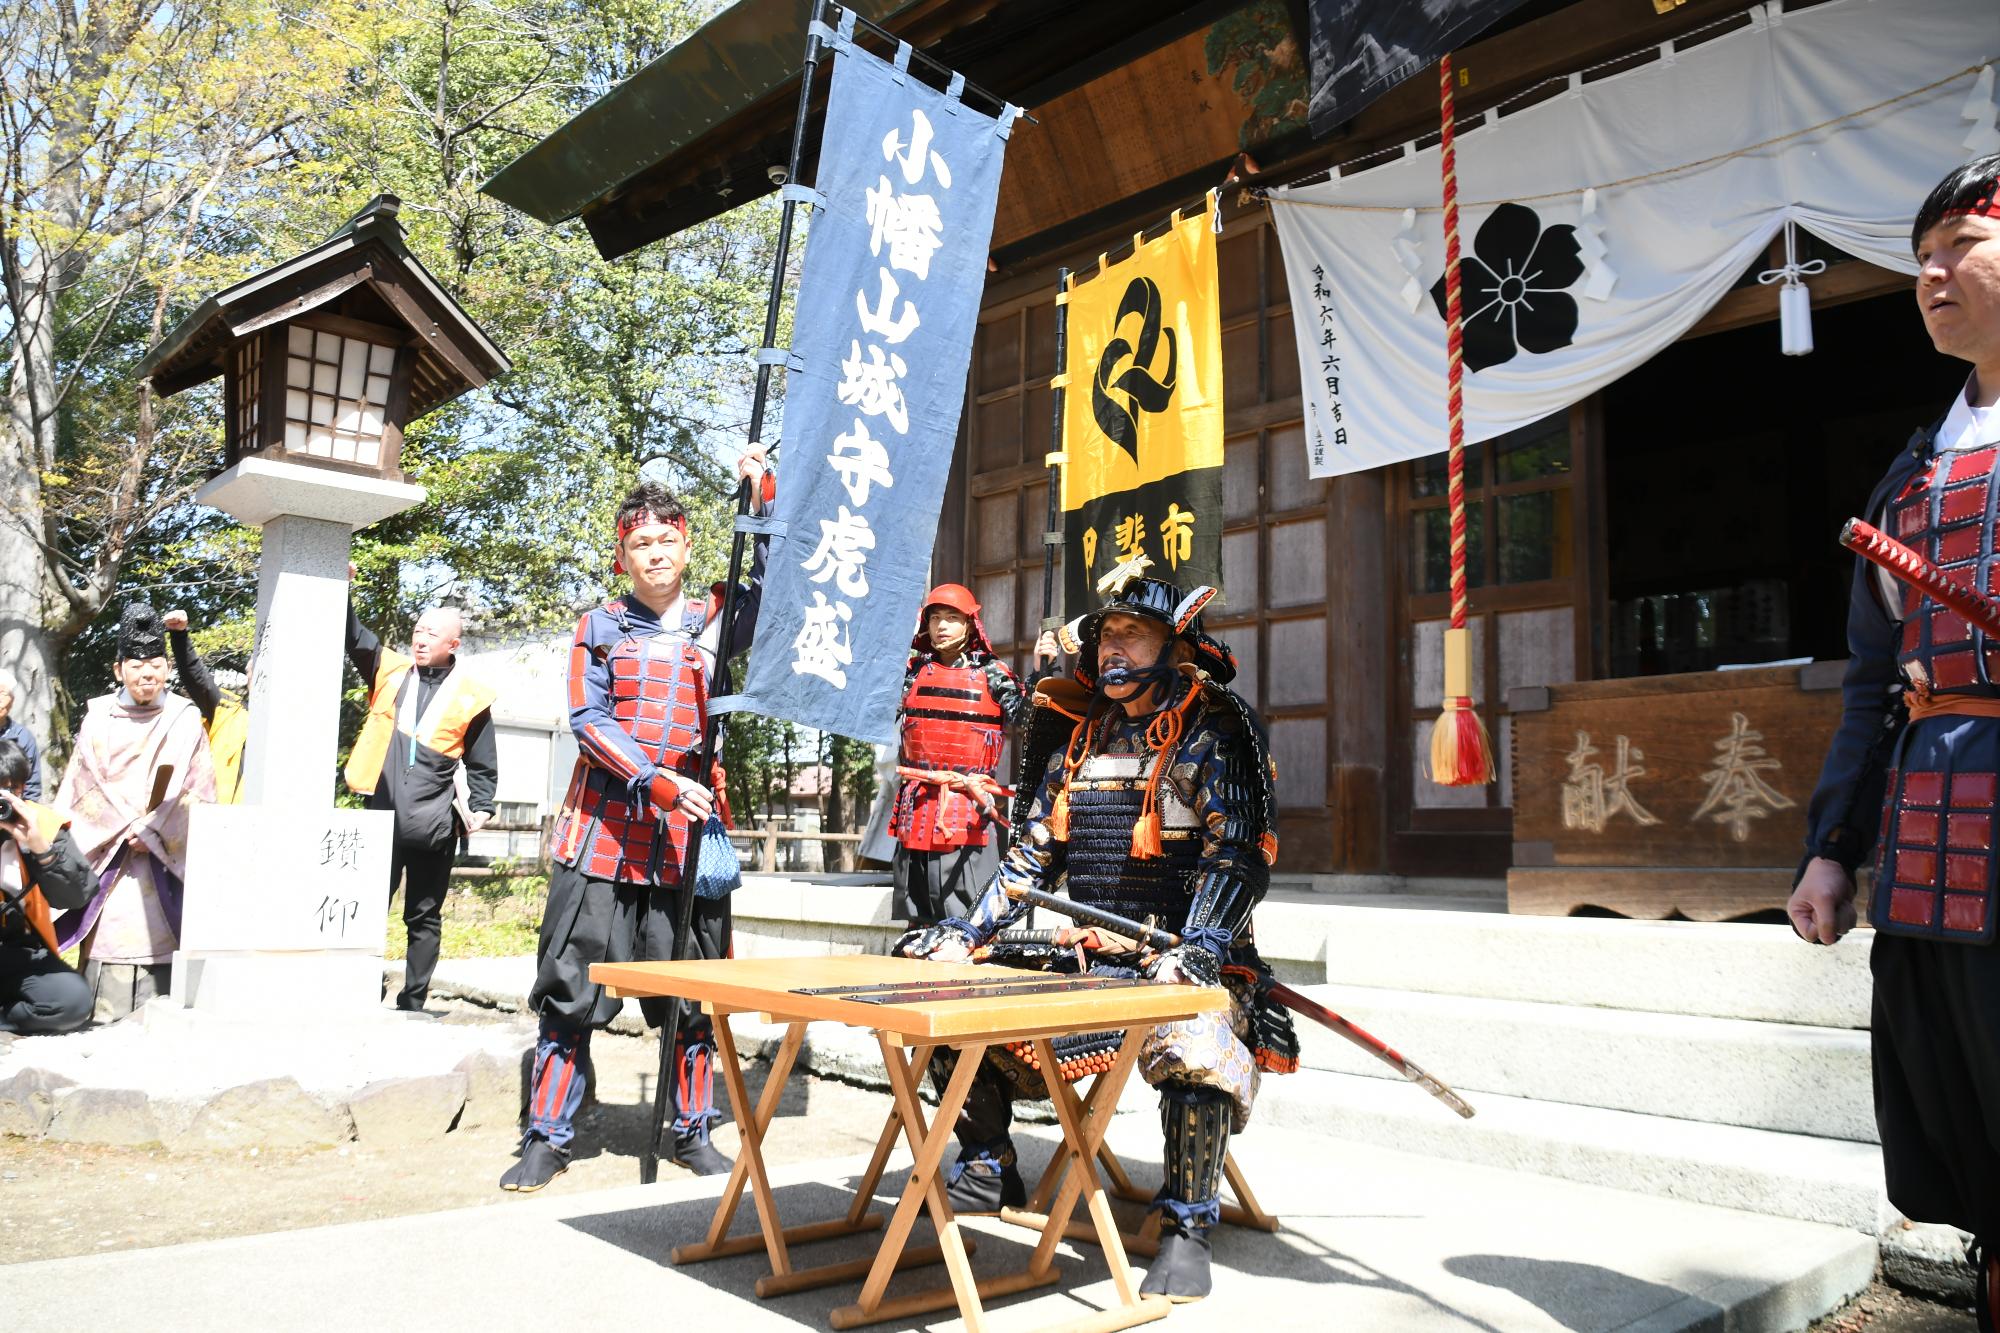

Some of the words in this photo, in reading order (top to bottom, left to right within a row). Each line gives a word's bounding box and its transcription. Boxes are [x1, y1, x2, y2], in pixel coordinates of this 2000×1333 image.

[791, 108, 951, 690] 小幡山城守虎盛
[1312, 264, 1348, 445] 令和六年六月吉日
